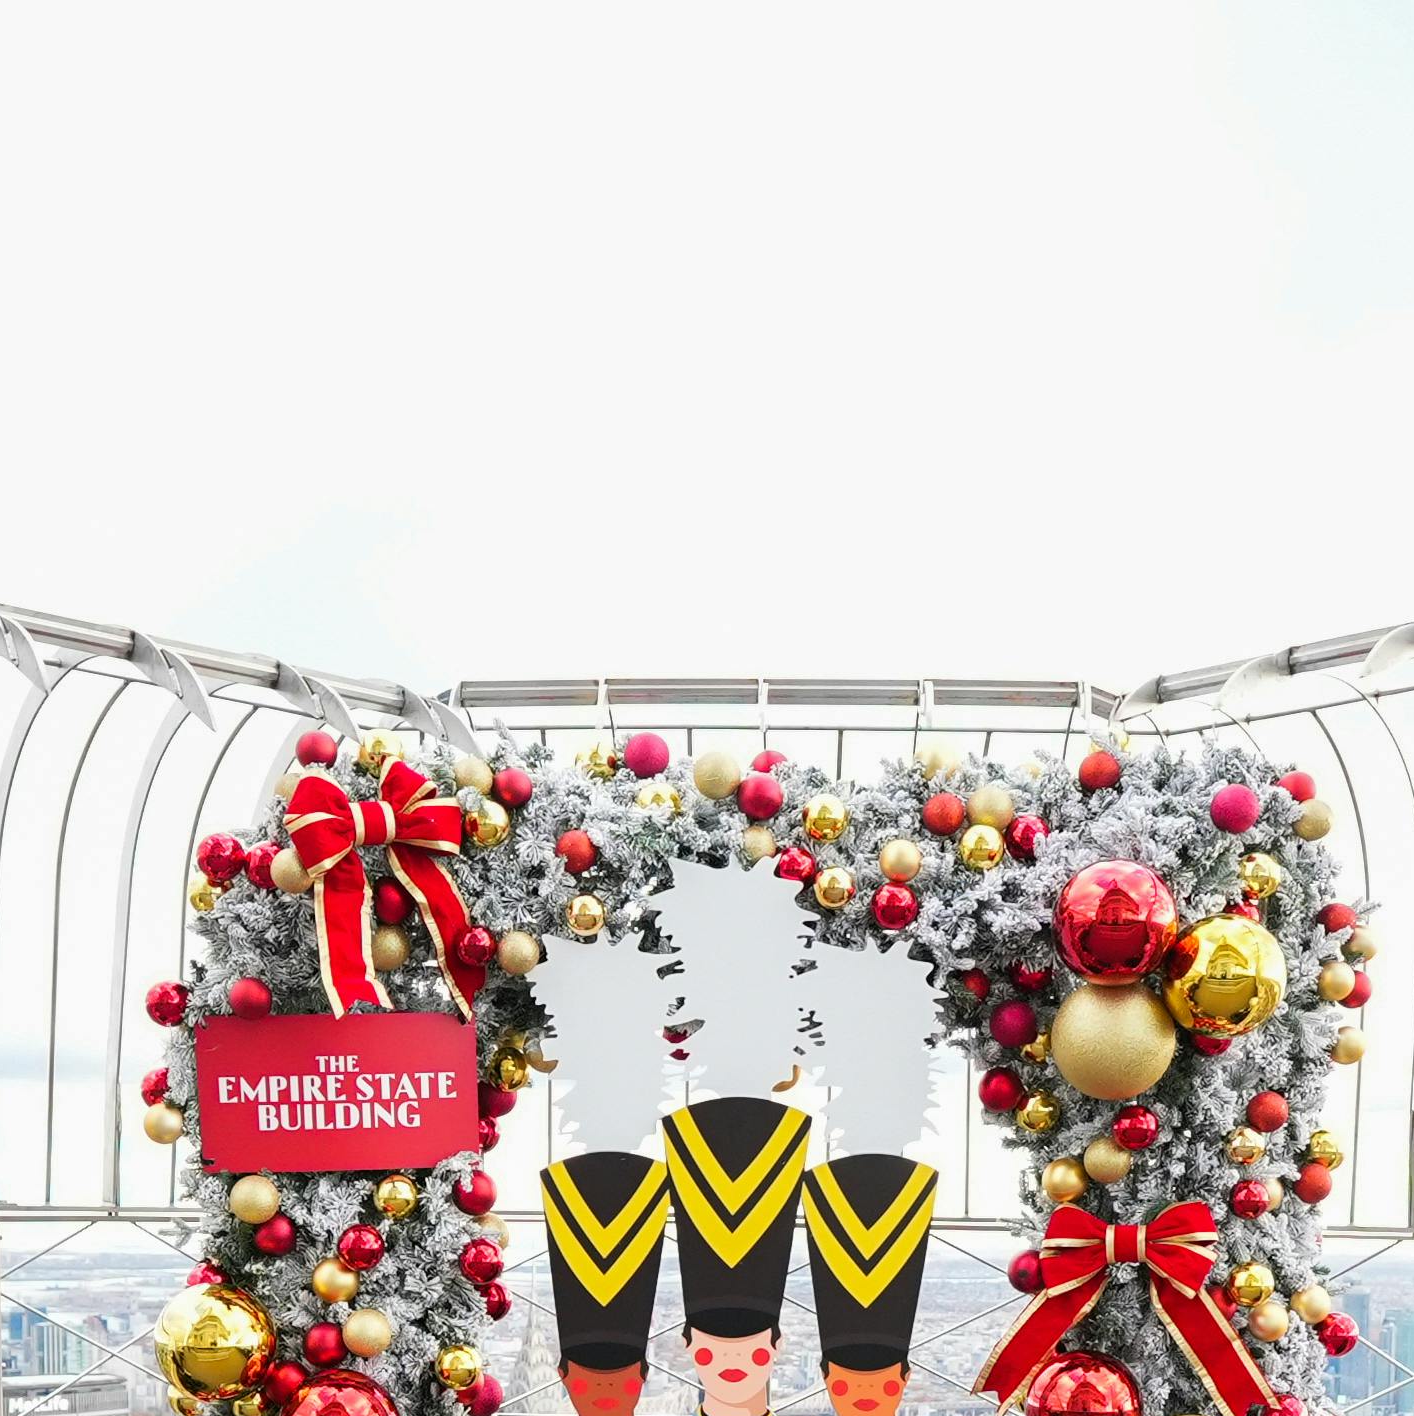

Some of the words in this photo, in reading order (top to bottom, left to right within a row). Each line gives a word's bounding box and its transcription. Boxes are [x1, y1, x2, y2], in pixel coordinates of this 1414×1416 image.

[315, 1055, 360, 1073] THE
[218, 1075, 347, 1103] EMPIRE
[355, 1072, 457, 1101] STATE
[258, 1101, 421, 1131] BUILDING
